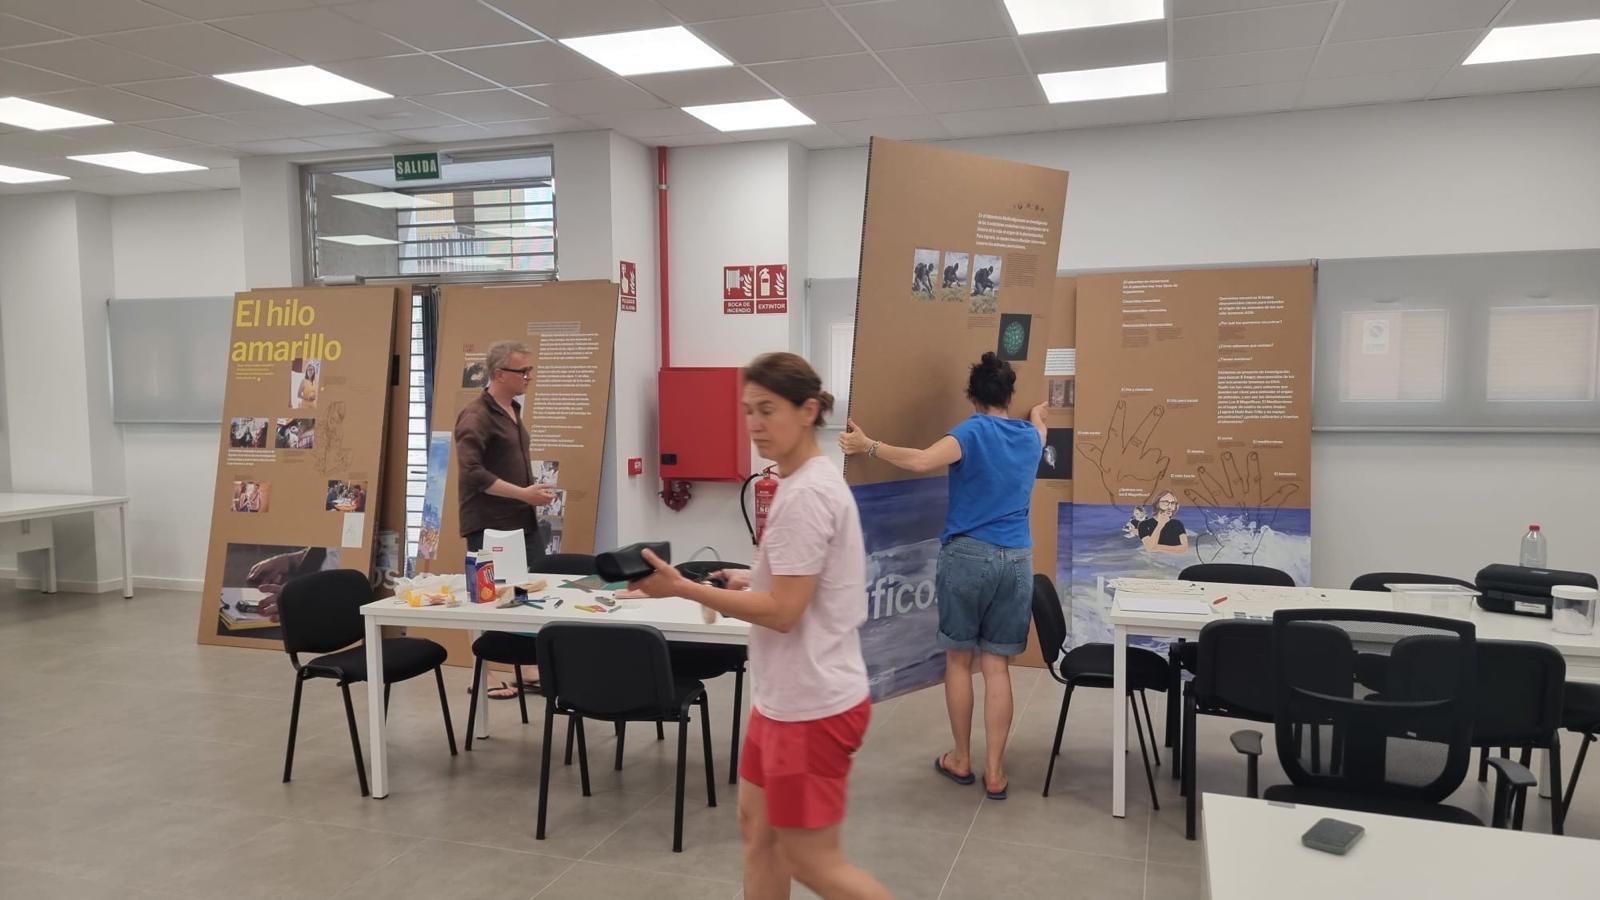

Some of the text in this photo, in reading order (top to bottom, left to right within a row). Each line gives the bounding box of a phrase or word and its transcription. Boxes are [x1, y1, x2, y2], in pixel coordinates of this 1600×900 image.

[396, 159, 437, 175] SALIDA
[236, 299, 315, 328] El hilo
[231, 333, 342, 361] amarillo
